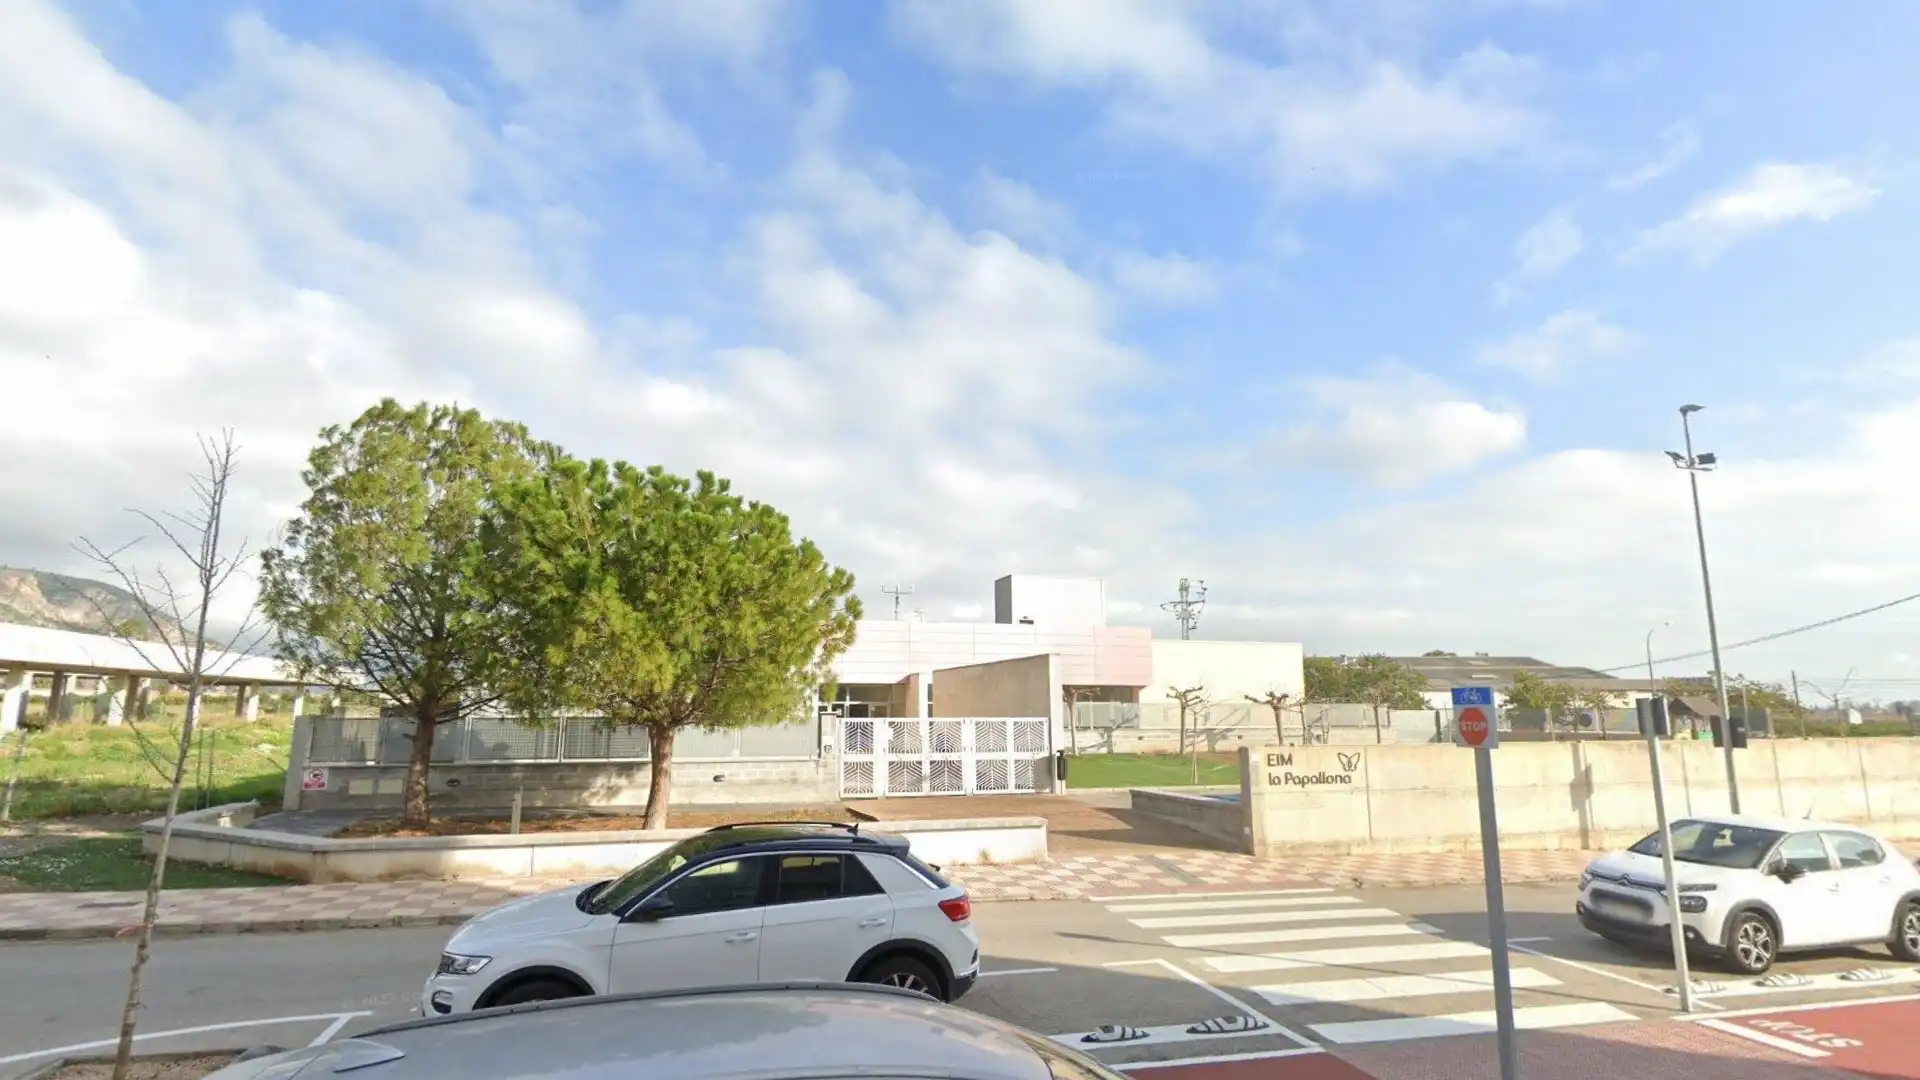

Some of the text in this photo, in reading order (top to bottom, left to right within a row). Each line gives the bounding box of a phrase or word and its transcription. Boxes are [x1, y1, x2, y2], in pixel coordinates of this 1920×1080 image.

[1460, 721, 1487, 731] STOP
[1267, 753, 1293, 767] EIM
[1268, 771, 1352, 788] la Papallona
